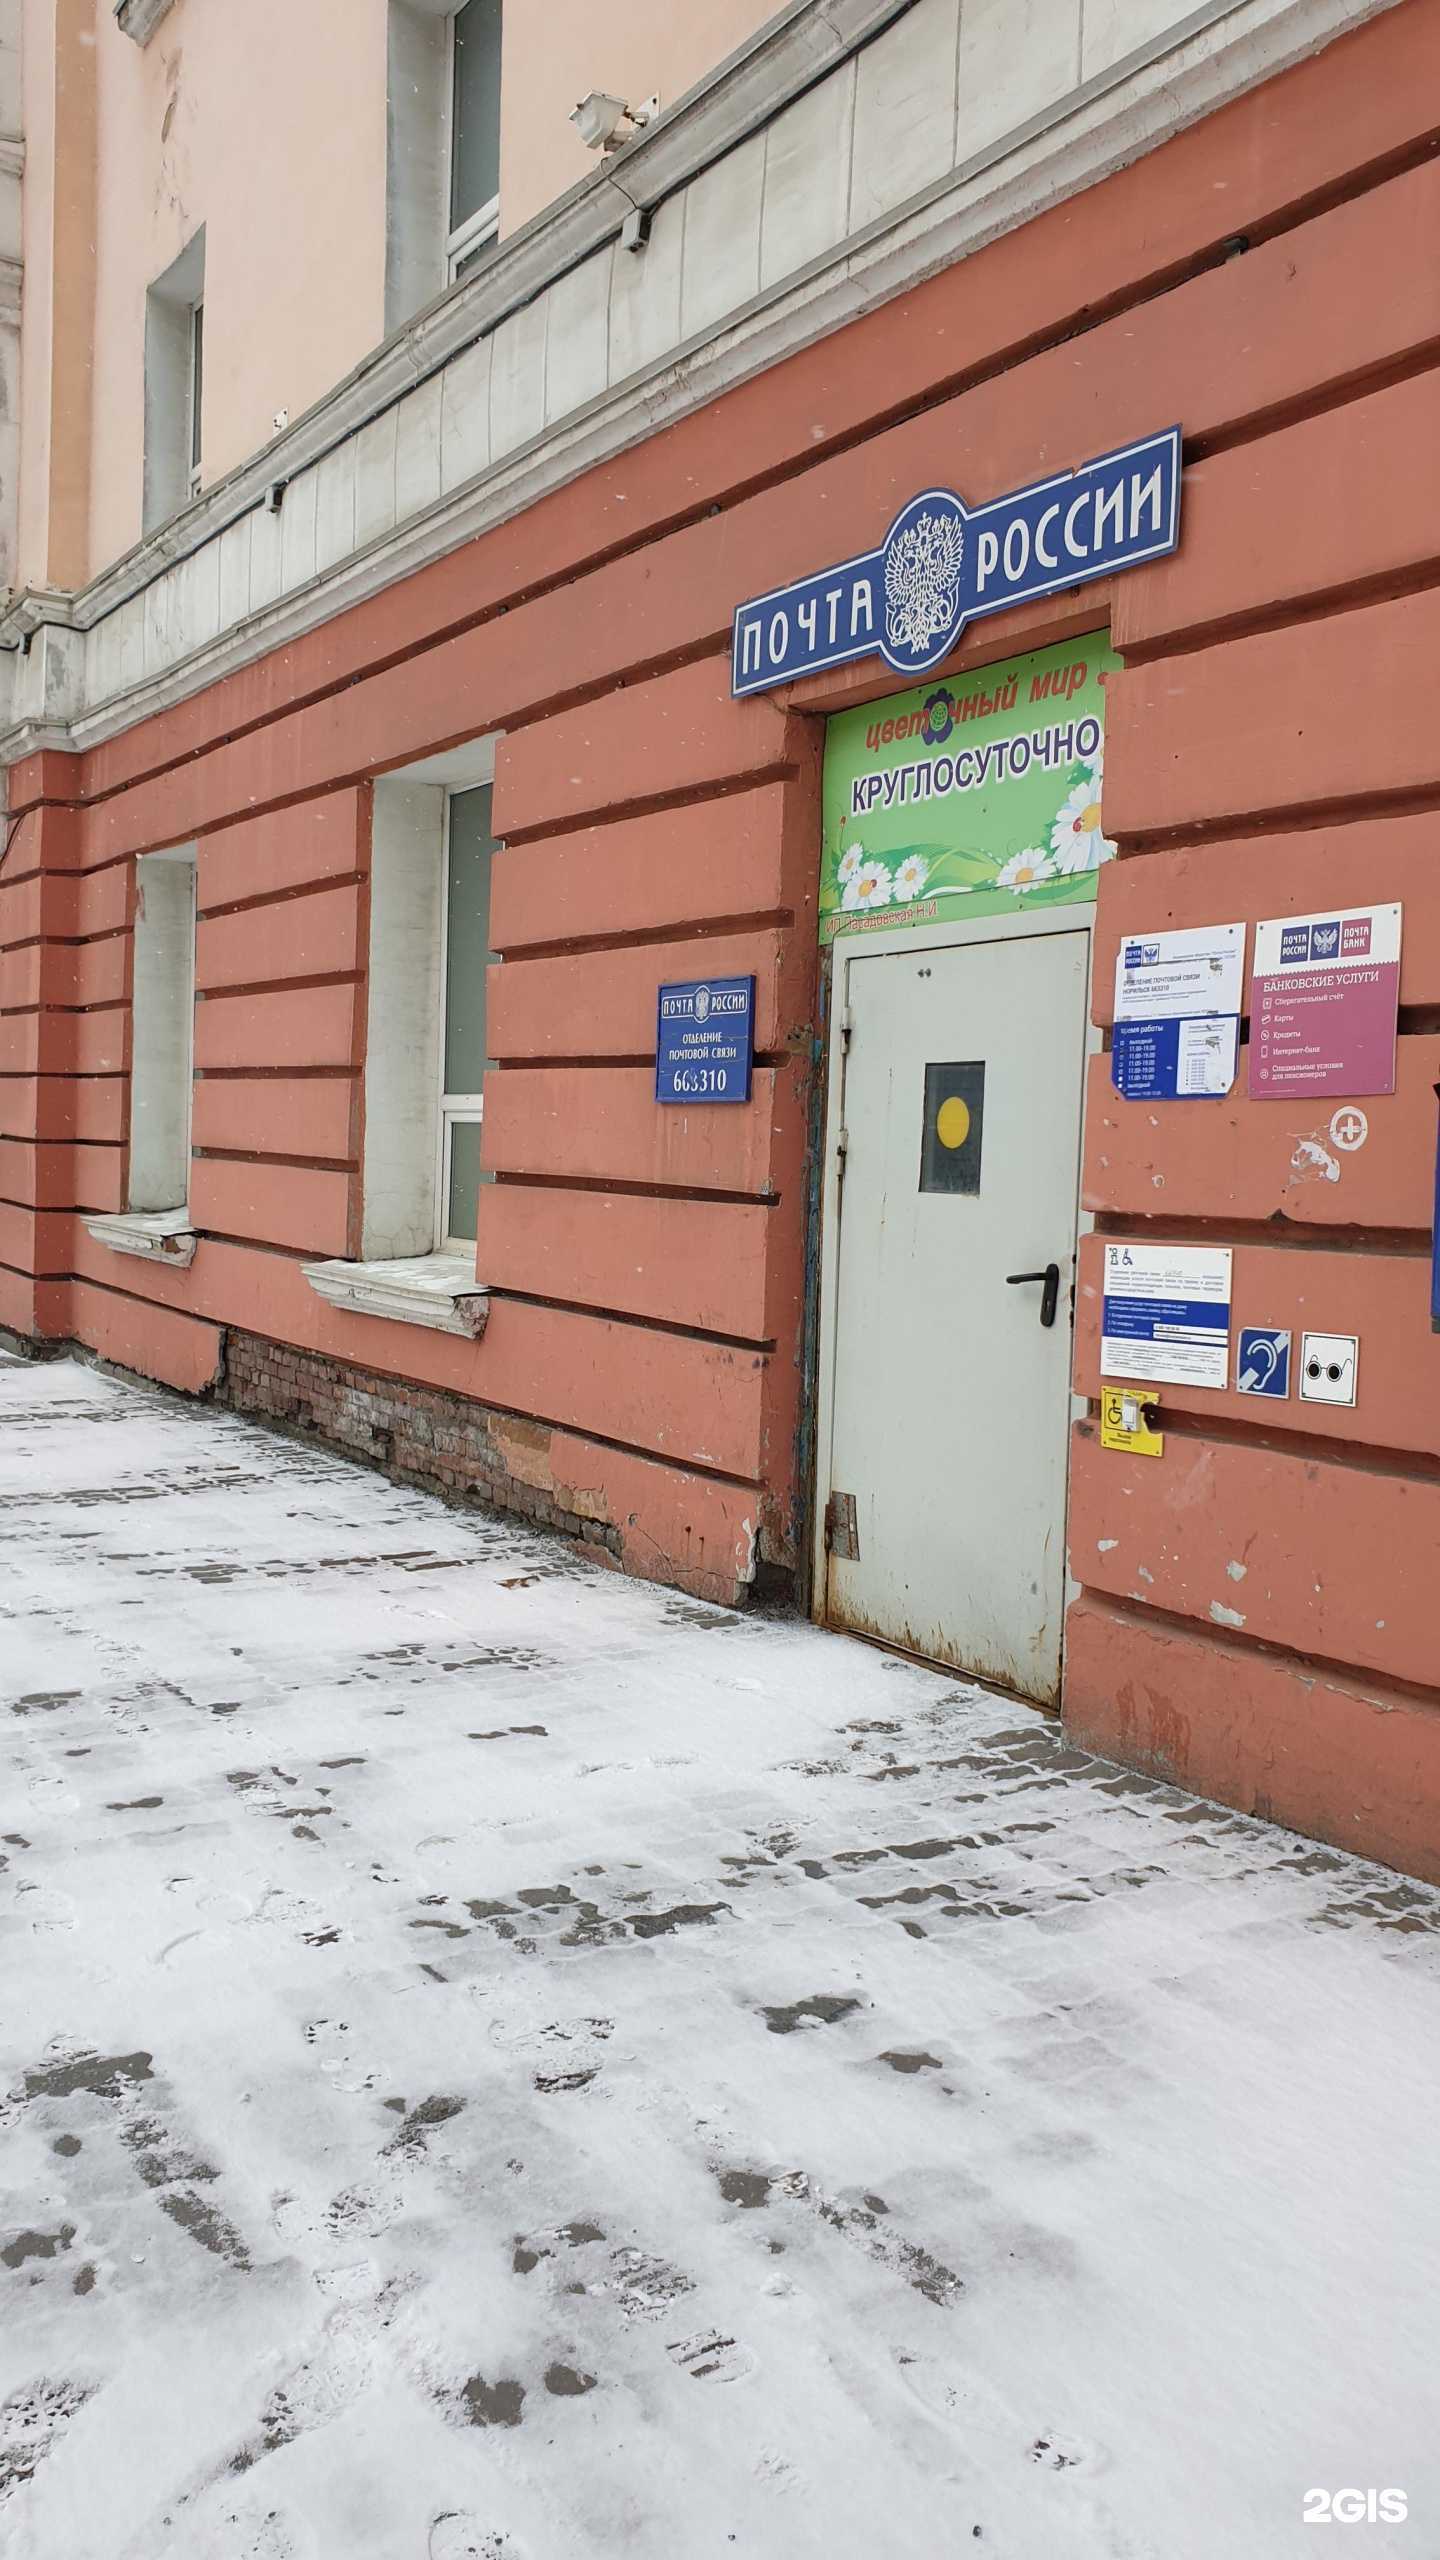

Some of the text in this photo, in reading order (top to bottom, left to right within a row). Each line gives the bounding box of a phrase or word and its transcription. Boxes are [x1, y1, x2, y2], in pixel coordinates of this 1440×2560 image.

[742, 463, 1162, 675] ПОЧТА РОССИИ
[1029, 661, 1088, 704] мир
[852, 718, 1101, 813] КРУГЛОСУТОЧНО
[1344, 926, 1369, 938] ПОЧТА
[1283, 934, 1307, 946] ПОЧТА
[1343, 938, 1365, 949] БАНК
[1282, 945, 1307, 957] РОССИИ
[1263, 971, 1380, 993] БАНКОВСКИЕ УСЛУГИ
[663, 994, 745, 1015] ПОЧТА РОССИИ
[682, 1031, 722, 1044] ОТДЕЛЕНИЕ
[669, 1046, 736, 1061] ПОЧТОВОЙ СВЯЗИ
